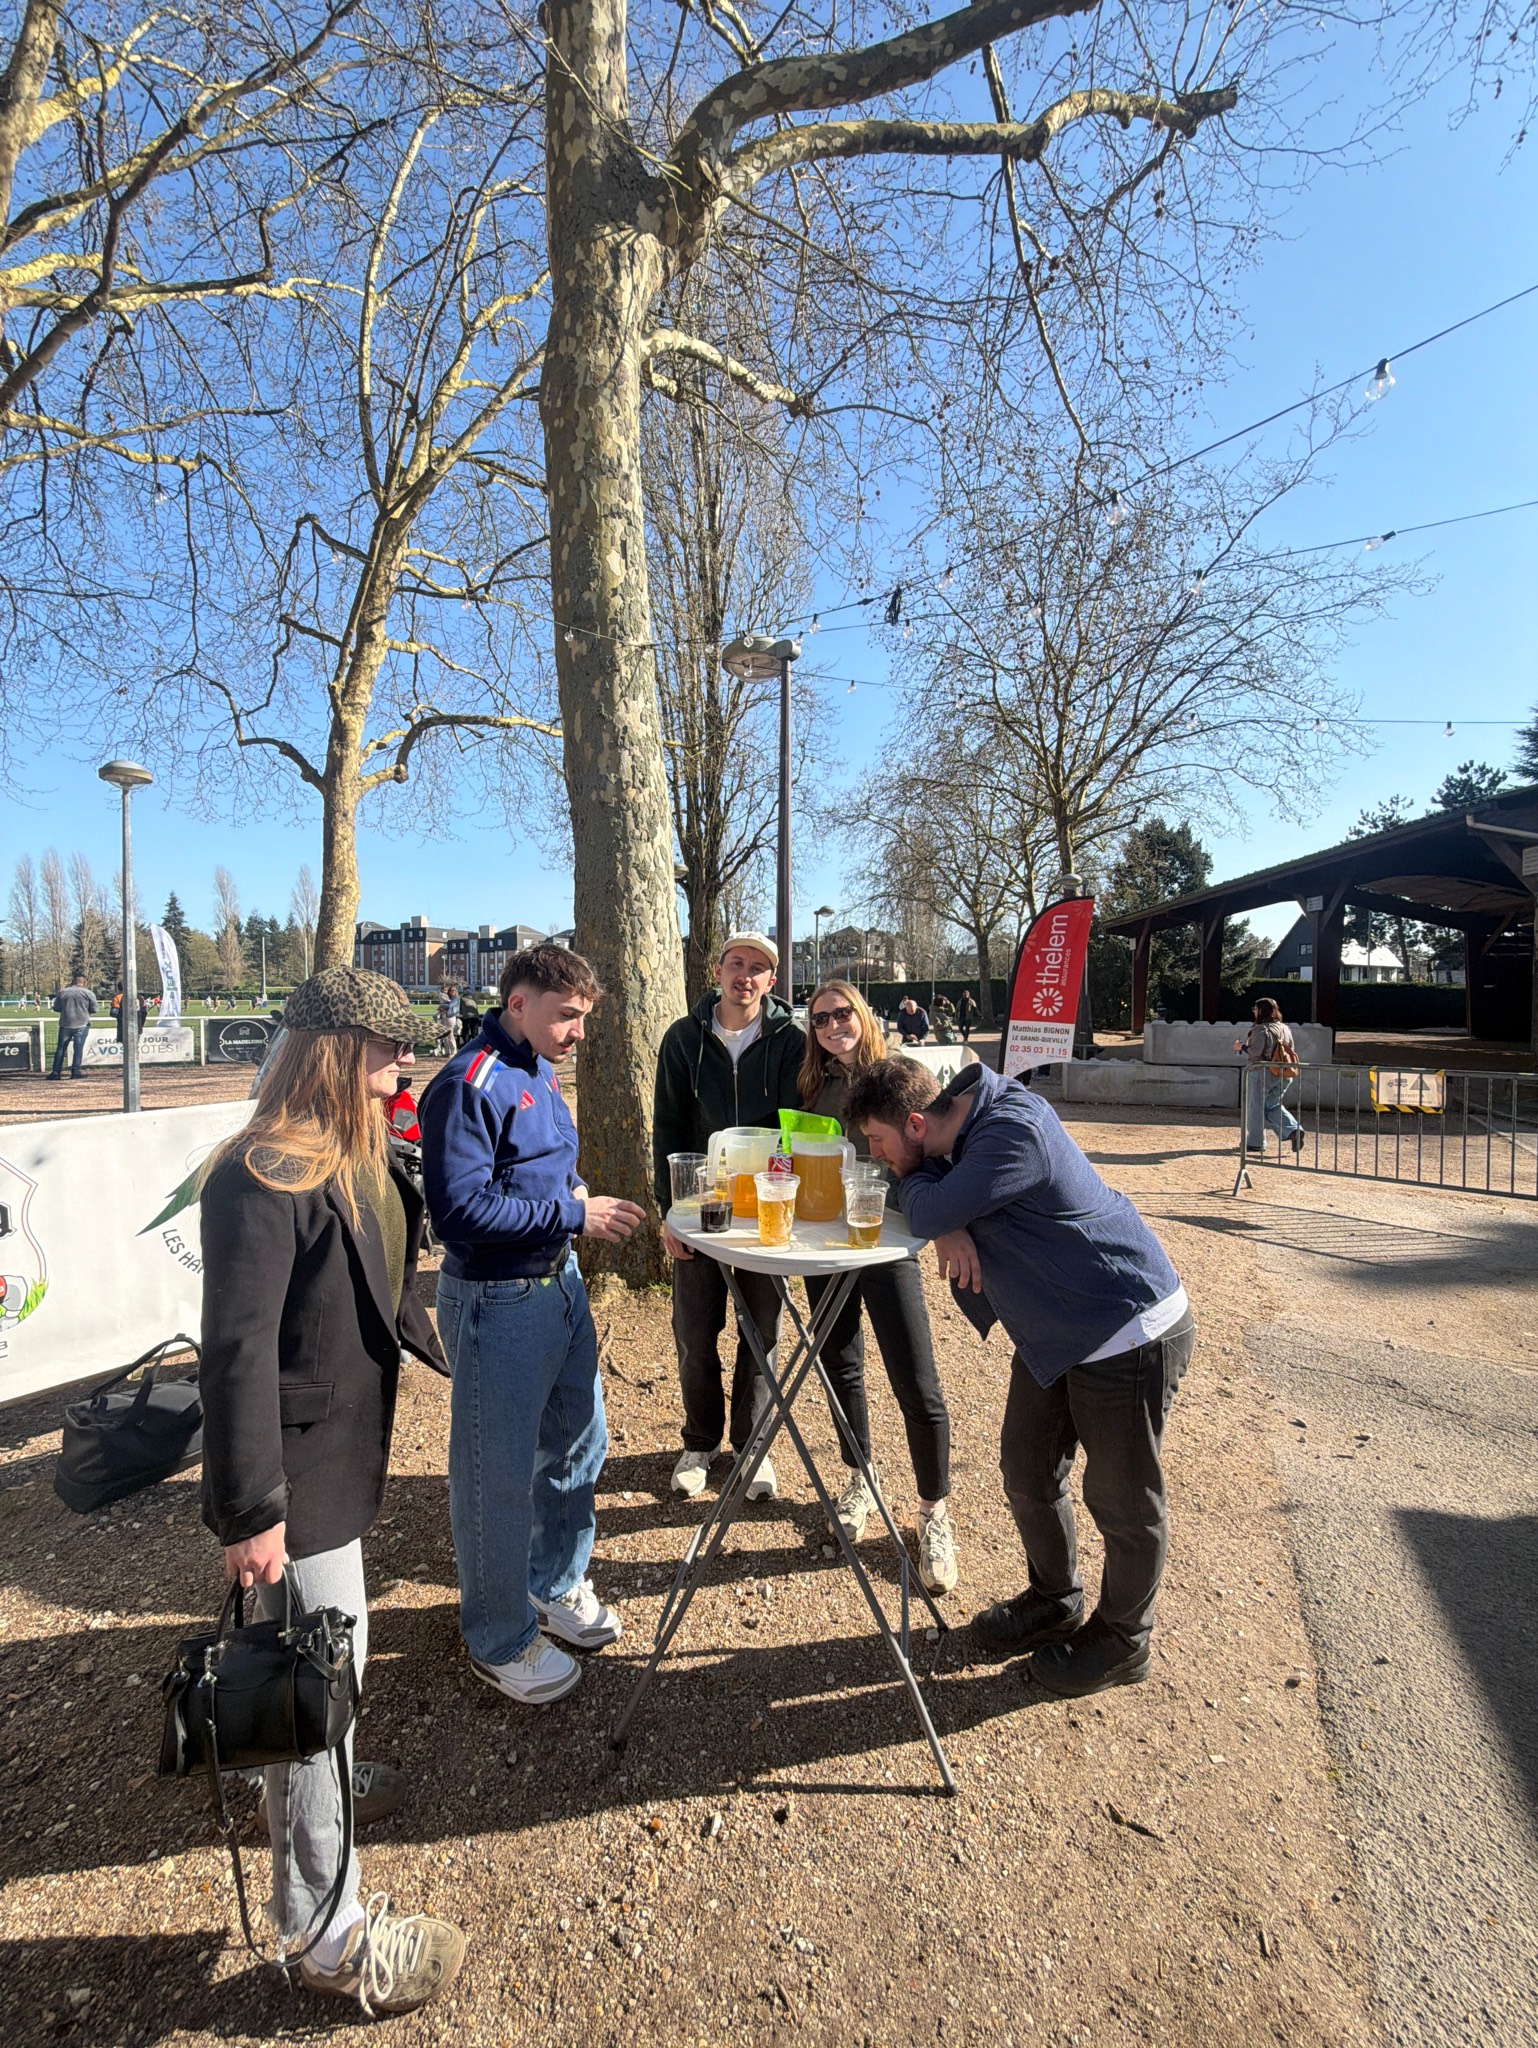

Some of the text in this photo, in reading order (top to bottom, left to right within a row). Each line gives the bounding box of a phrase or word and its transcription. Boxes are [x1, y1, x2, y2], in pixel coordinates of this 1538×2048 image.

[1035, 914, 1069, 985] thélem
[1061, 948, 1072, 986] assurances
[1012, 1025, 1070, 1035] Matthias BIGNON
[142, 1036, 169, 1044] JOUR
[1033, 1046, 1044, 1054] 03
[1046, 1047, 1055, 1055] 11
[1059, 1048, 1068, 1056] 15
[162, 1228, 185, 1254] LES
